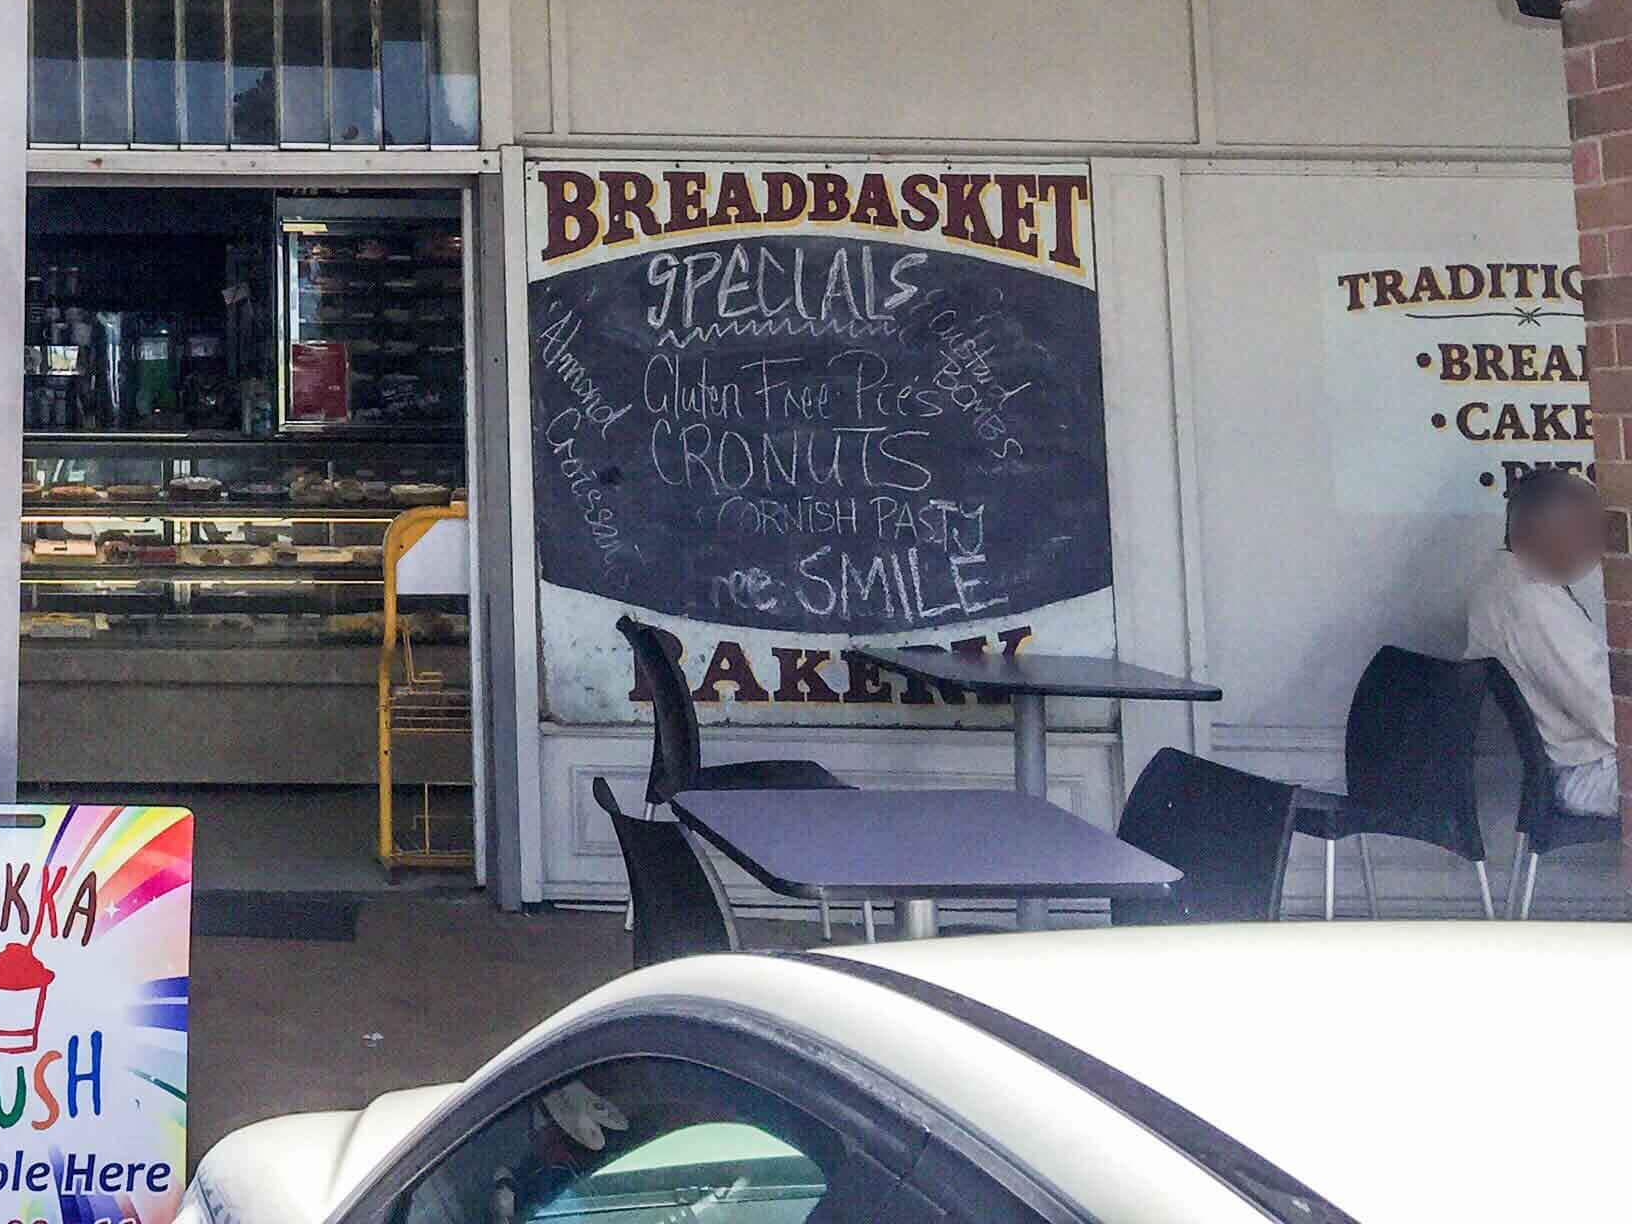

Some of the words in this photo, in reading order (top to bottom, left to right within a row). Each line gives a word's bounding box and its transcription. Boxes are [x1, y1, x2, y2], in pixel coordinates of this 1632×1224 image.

[538, 170, 1090, 272] BREADBASKET
[647, 245, 929, 328] SPECIALS
[540, 310, 632, 439] Almond
[644, 354, 741, 419] Gluten
[741, 359, 832, 419] Free
[1438, 344, 1589, 381] BREA
[650, 420, 932, 493] CRONUTS
[717, 497, 858, 537] CORNISH
[871, 498, 986, 556] PASTY
[796, 545, 1009, 623] SMILE
[65, 1153, 171, 1192] Here
